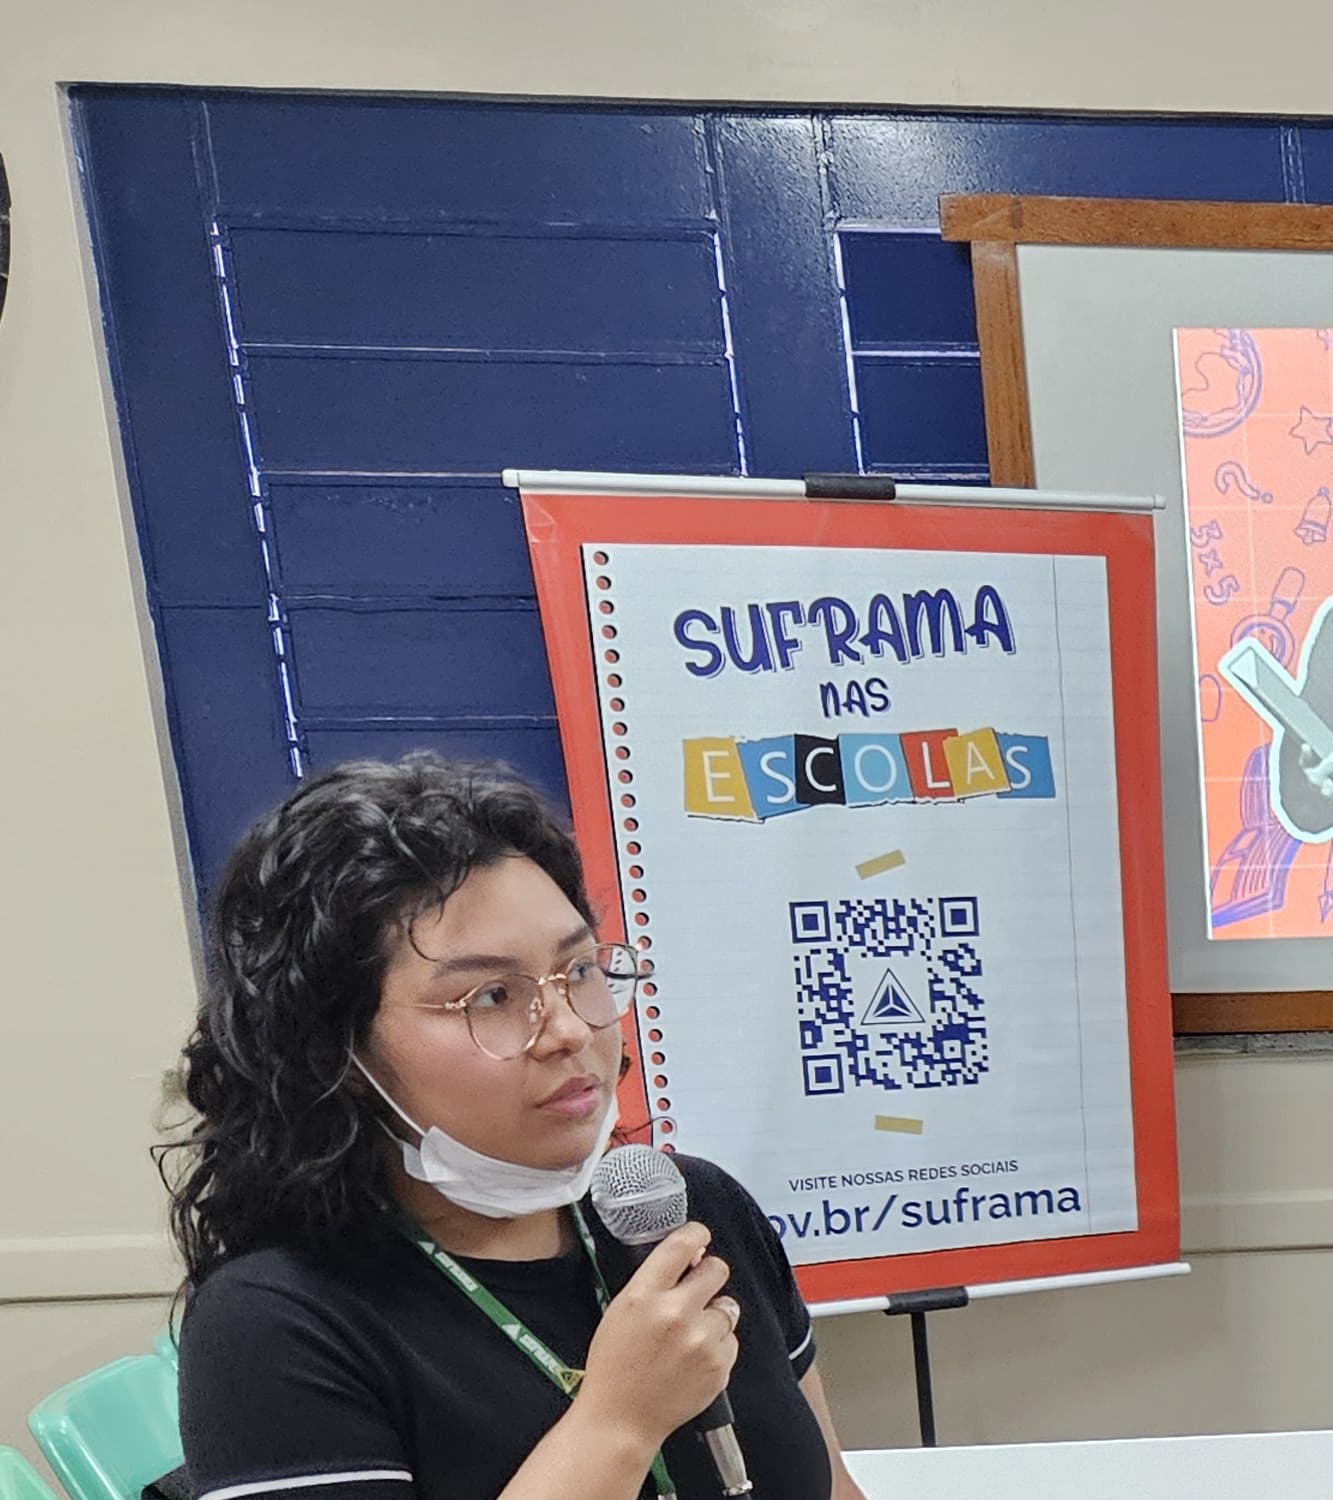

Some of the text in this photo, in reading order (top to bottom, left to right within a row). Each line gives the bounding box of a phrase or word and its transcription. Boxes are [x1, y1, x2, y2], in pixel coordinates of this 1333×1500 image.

[673, 584, 1016, 678] SUFRAMA
[818, 677, 891, 719] NAS
[702, 741, 1033, 804] ESCOLAS
[788, 1160, 1019, 1192] VISITE NOSSAS REDES SOCIAIS
[766, 1186, 1082, 1240] ov.br/suframa
